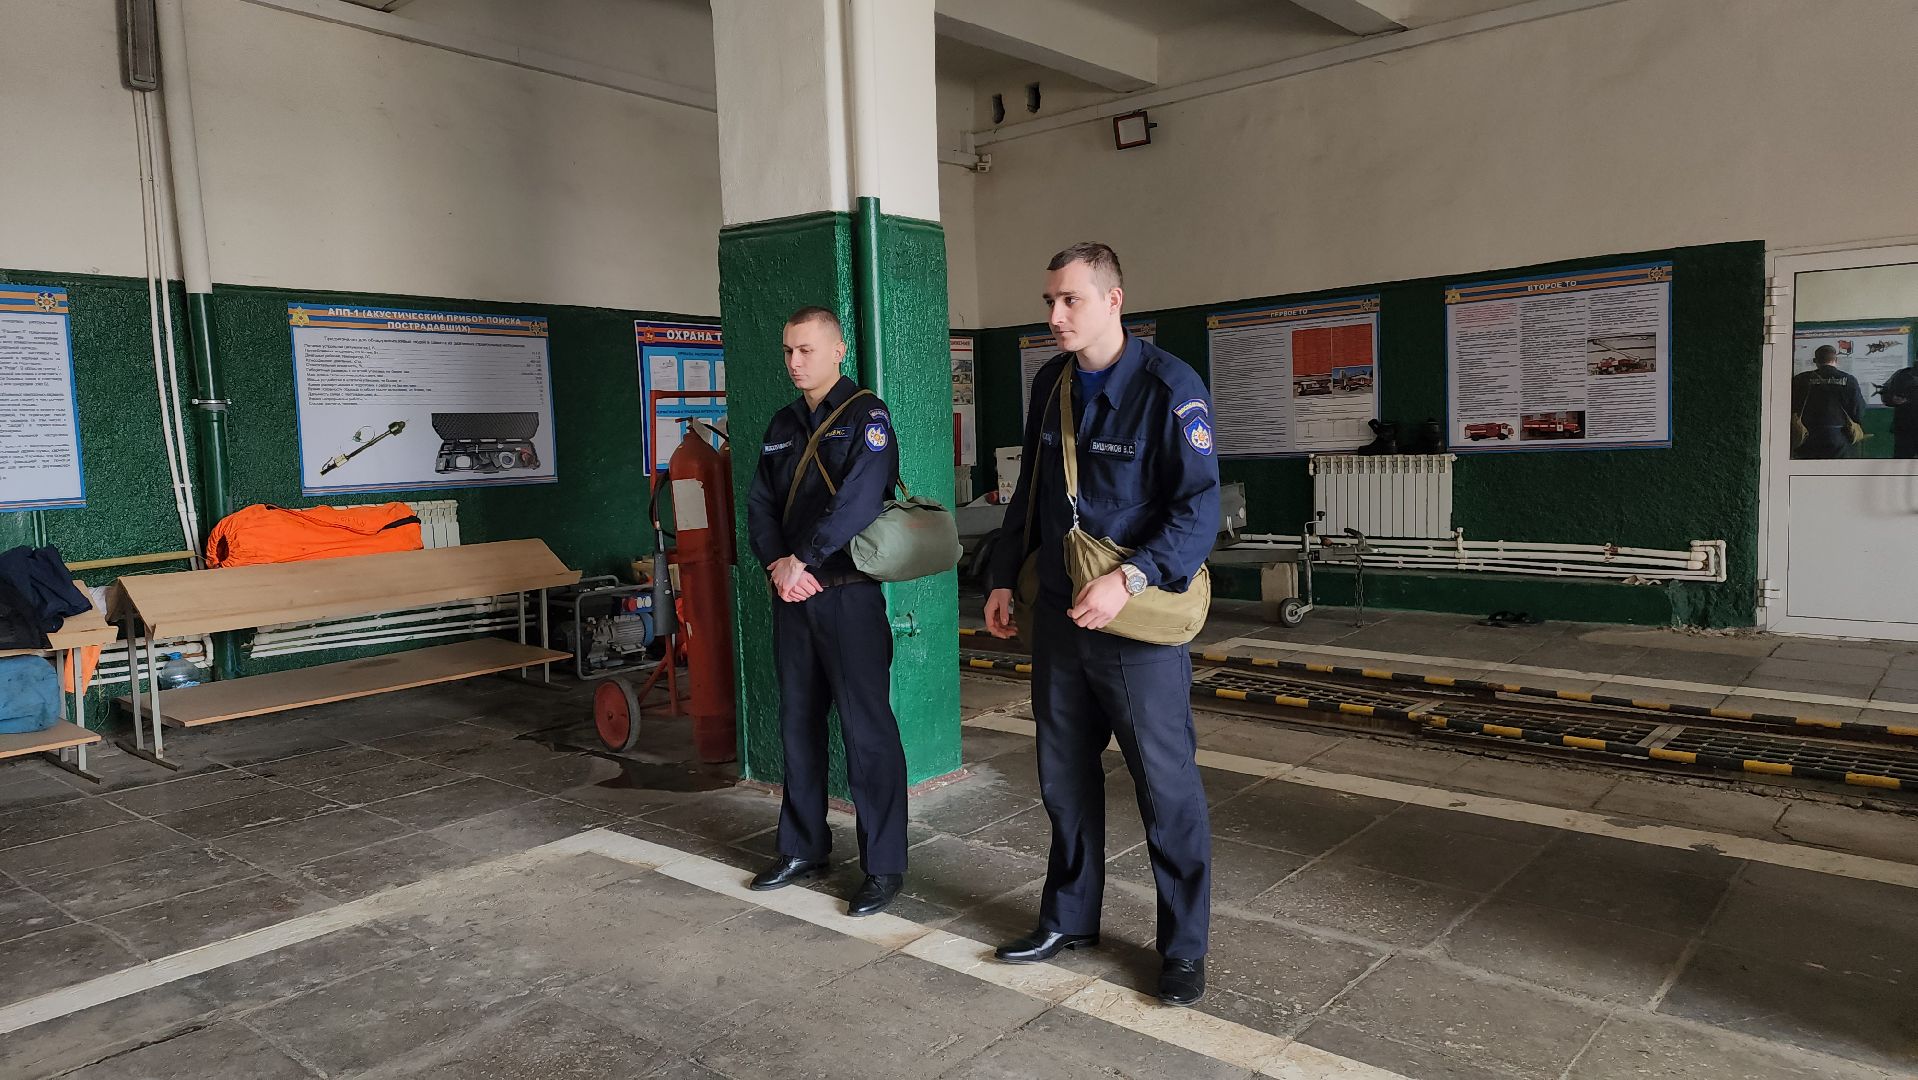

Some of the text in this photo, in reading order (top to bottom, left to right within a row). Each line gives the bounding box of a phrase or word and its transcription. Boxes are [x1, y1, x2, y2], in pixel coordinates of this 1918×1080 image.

[328, 307, 521, 325] АПП-1 (АКУСТИЧЕСКИЙ ПРИБОР ПОИСКА
[387, 321, 471, 333] ПОСТРАДАВШИХ)
[666, 329, 722, 342] ОХРАНА Т
